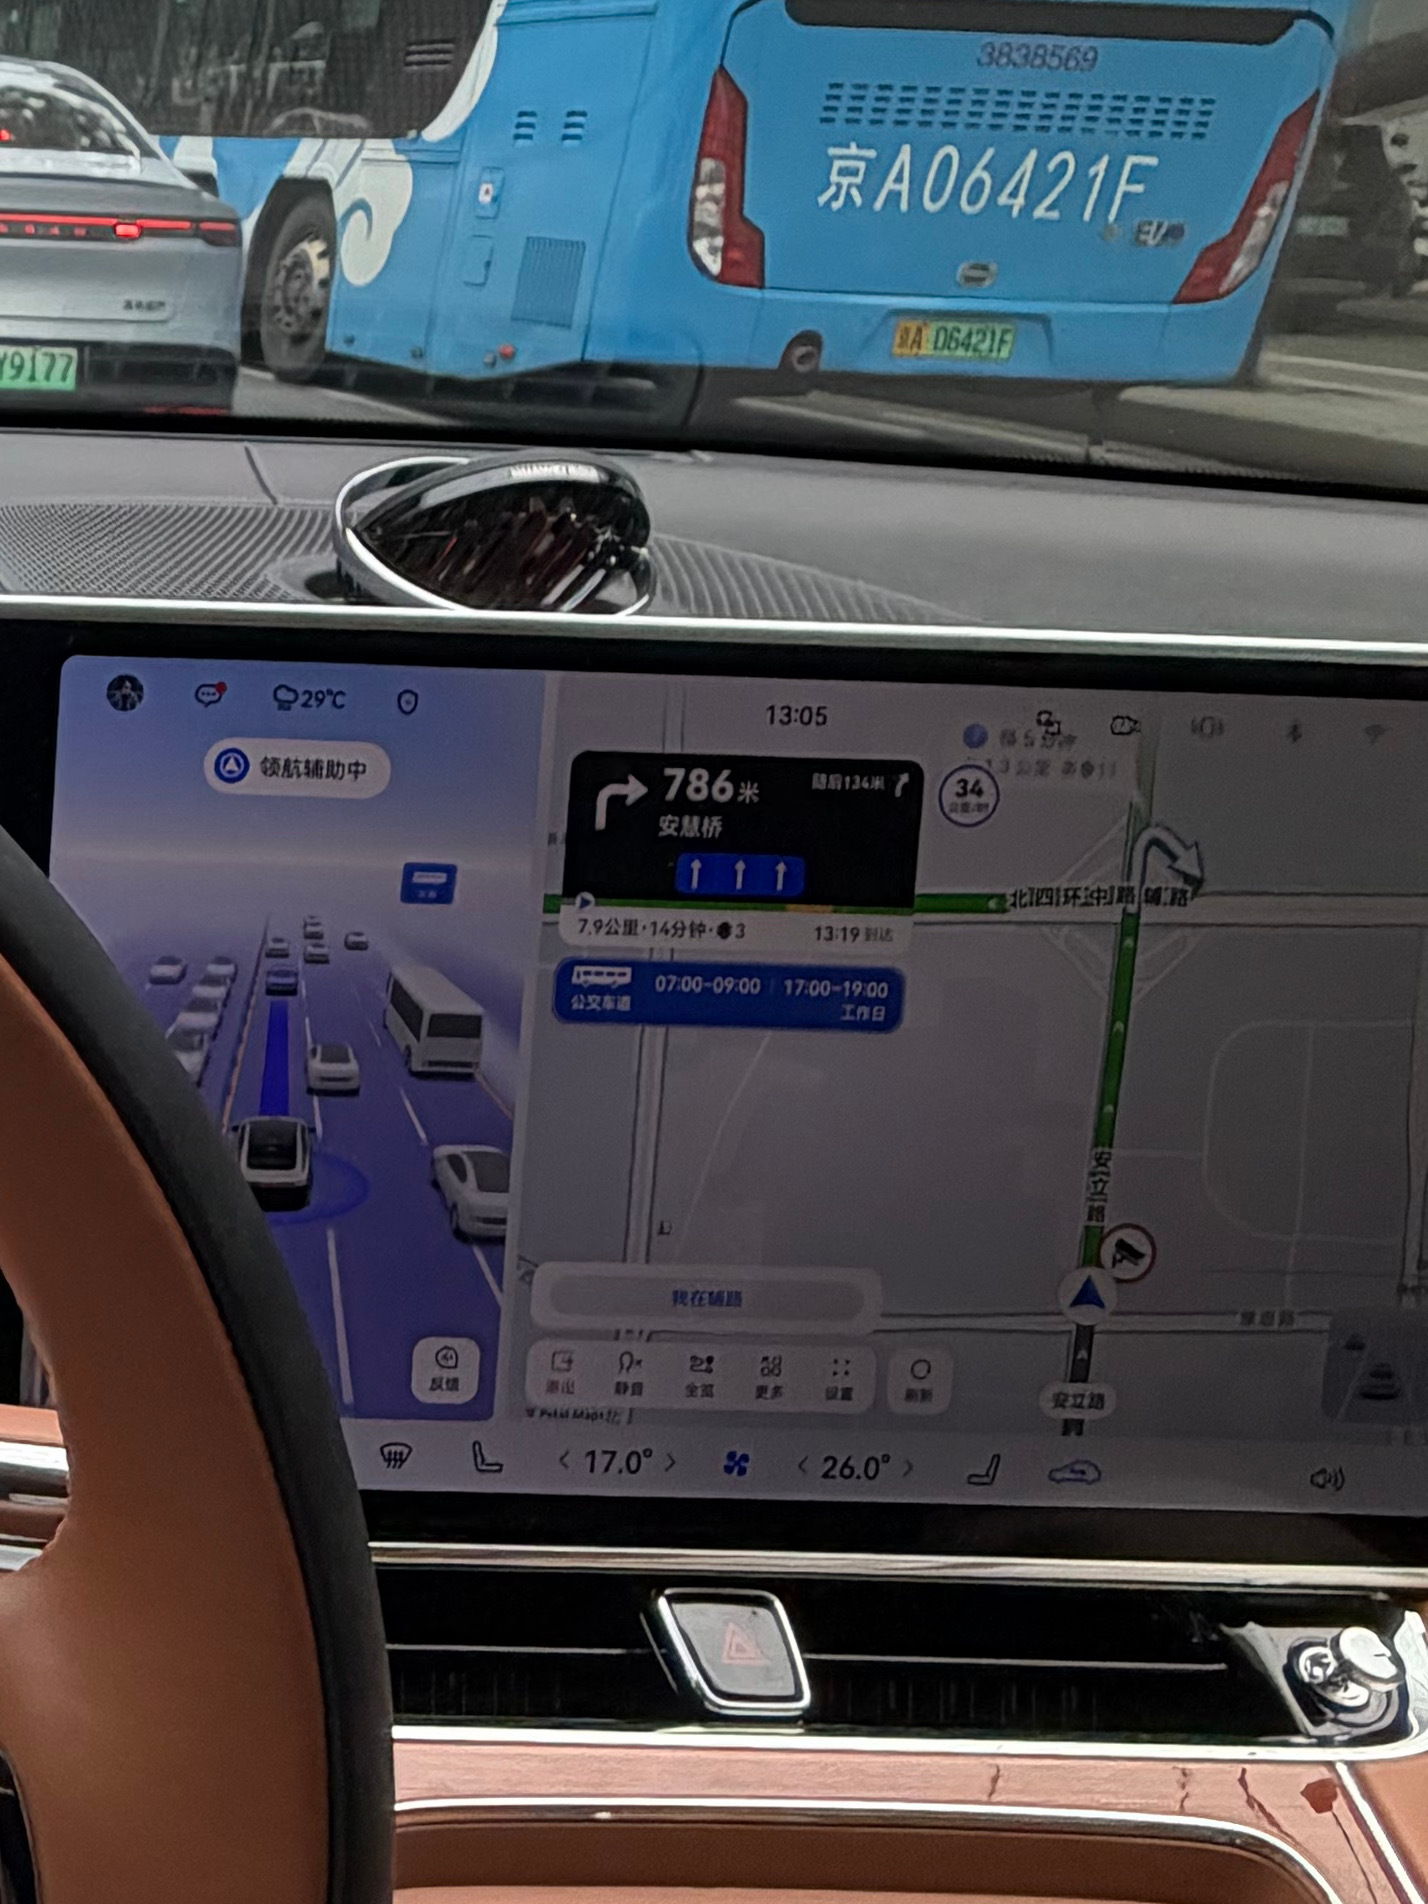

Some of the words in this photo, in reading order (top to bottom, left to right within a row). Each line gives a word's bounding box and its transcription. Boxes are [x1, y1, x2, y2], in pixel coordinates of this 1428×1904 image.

[817, 142, 1160, 223] 京A06421F
[765, 704, 828, 727] 13:05
[259, 755, 368, 783] 领航辅助中
[954, 778, 985, 798] 34
[658, 814, 724, 840] 安慧桥
[814, 923, 862, 944] 13:19
[654, 973, 762, 995] 07:00-09:00
[783, 977, 890, 1000] 17:00-19:00
[571, 994, 632, 1012] 公交车道
[840, 1003, 886, 1022] 工作日
[585, 1448, 654, 1474] 17.0°
[820, 1454, 891, 1481] 26.0°
